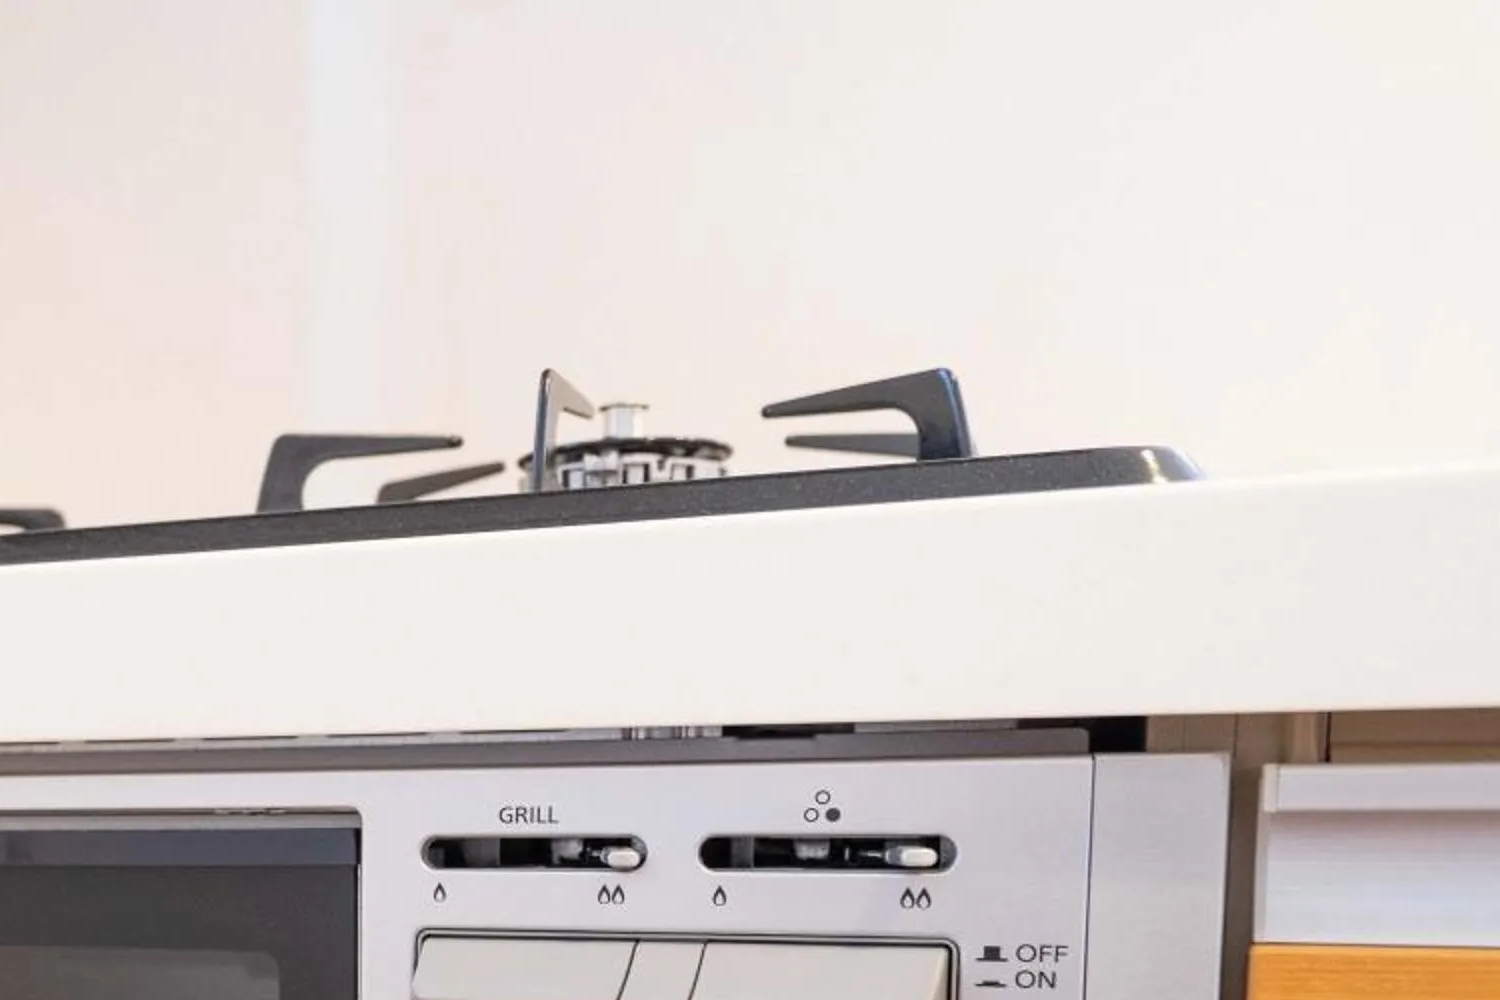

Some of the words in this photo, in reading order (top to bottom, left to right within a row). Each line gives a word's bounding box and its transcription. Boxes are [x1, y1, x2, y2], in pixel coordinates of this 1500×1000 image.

[499, 805, 560, 825] GRILL
[1015, 943, 1069, 963] OFF
[1015, 969, 1057, 989] ON
